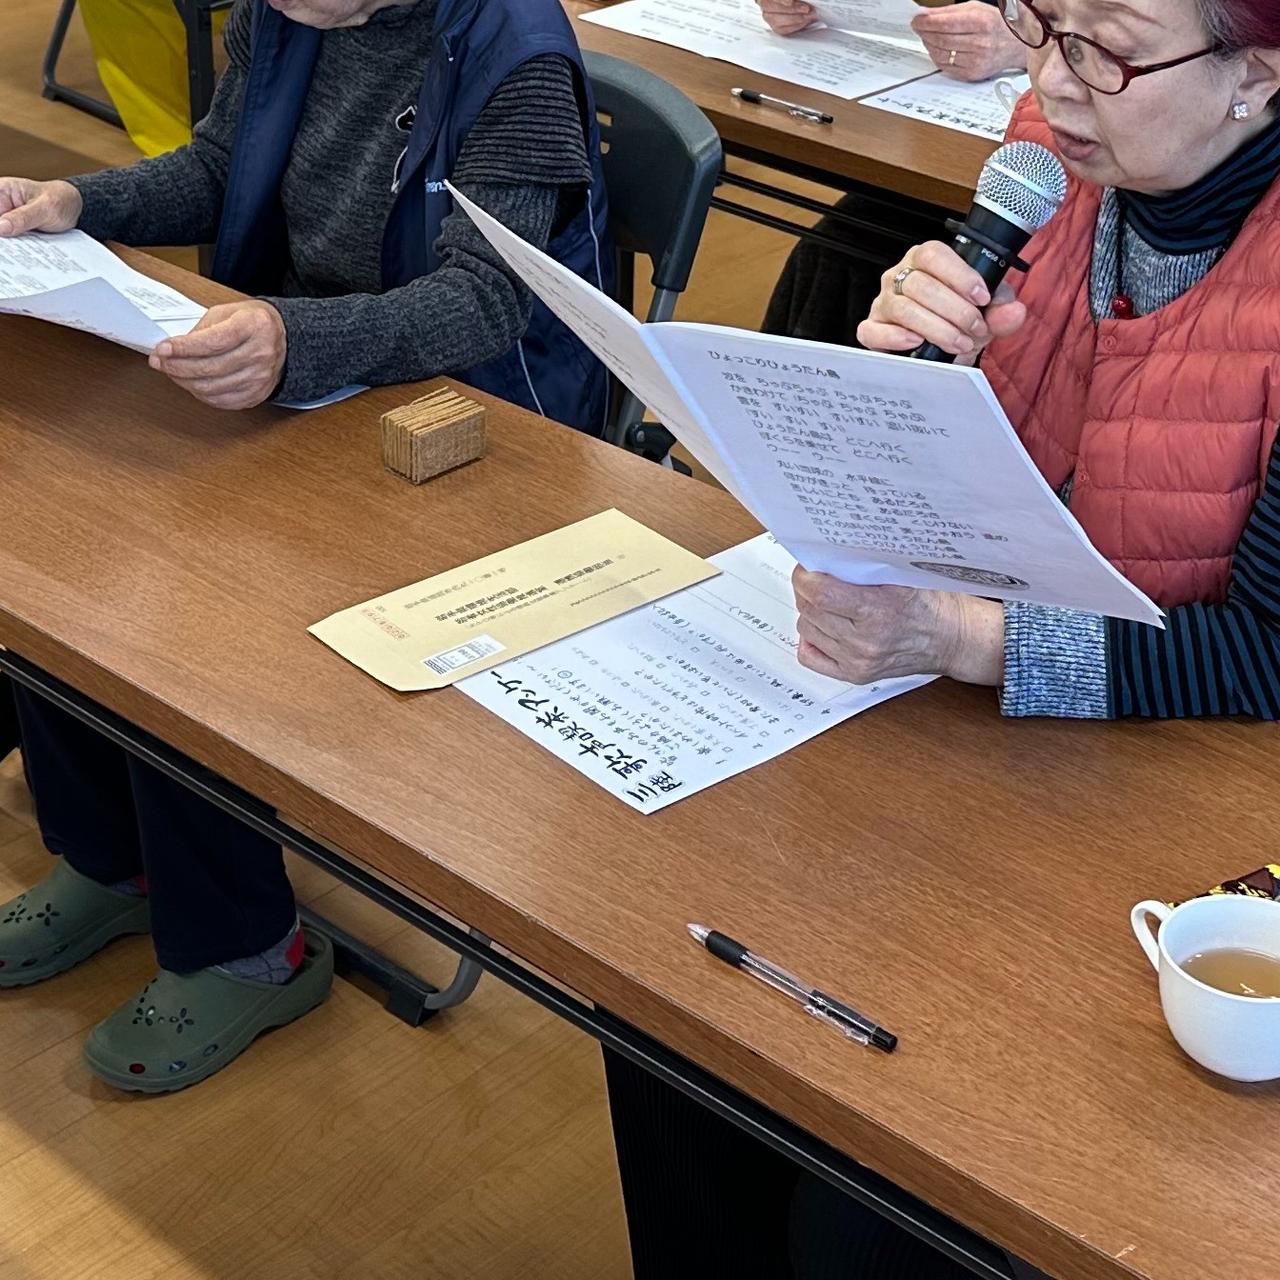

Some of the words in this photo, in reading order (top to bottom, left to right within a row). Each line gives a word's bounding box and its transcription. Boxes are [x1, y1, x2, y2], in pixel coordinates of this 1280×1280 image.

[707, 350, 841, 380] ひょっこりひょうたん島
